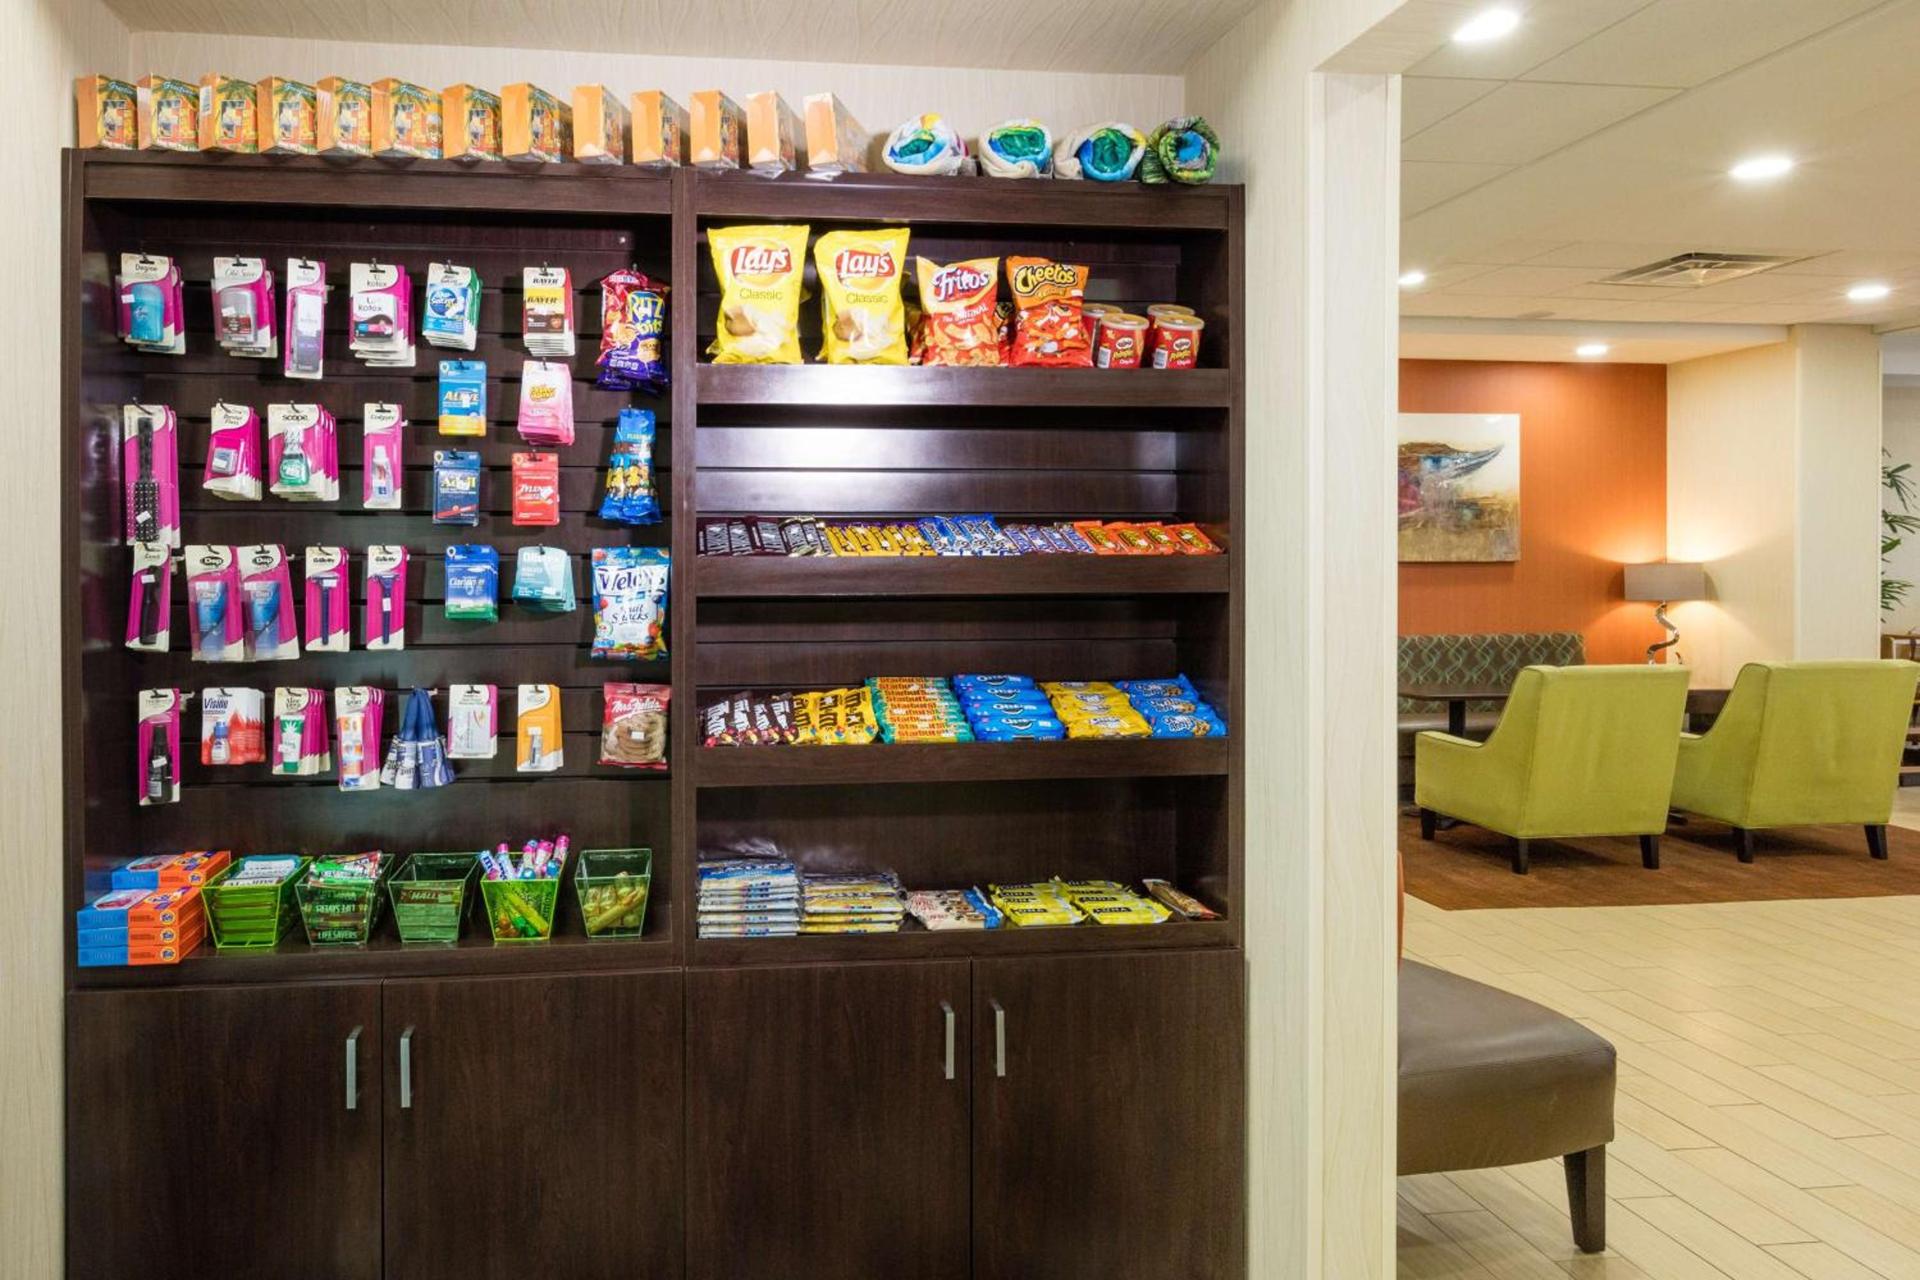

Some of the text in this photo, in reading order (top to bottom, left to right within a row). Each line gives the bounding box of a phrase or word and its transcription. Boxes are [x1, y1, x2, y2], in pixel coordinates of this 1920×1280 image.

[932, 267, 990, 301] Fritos
[1016, 264, 1075, 293] Cheetos
[739, 288, 784, 300] Classic
[846, 293, 889, 304] Classic
